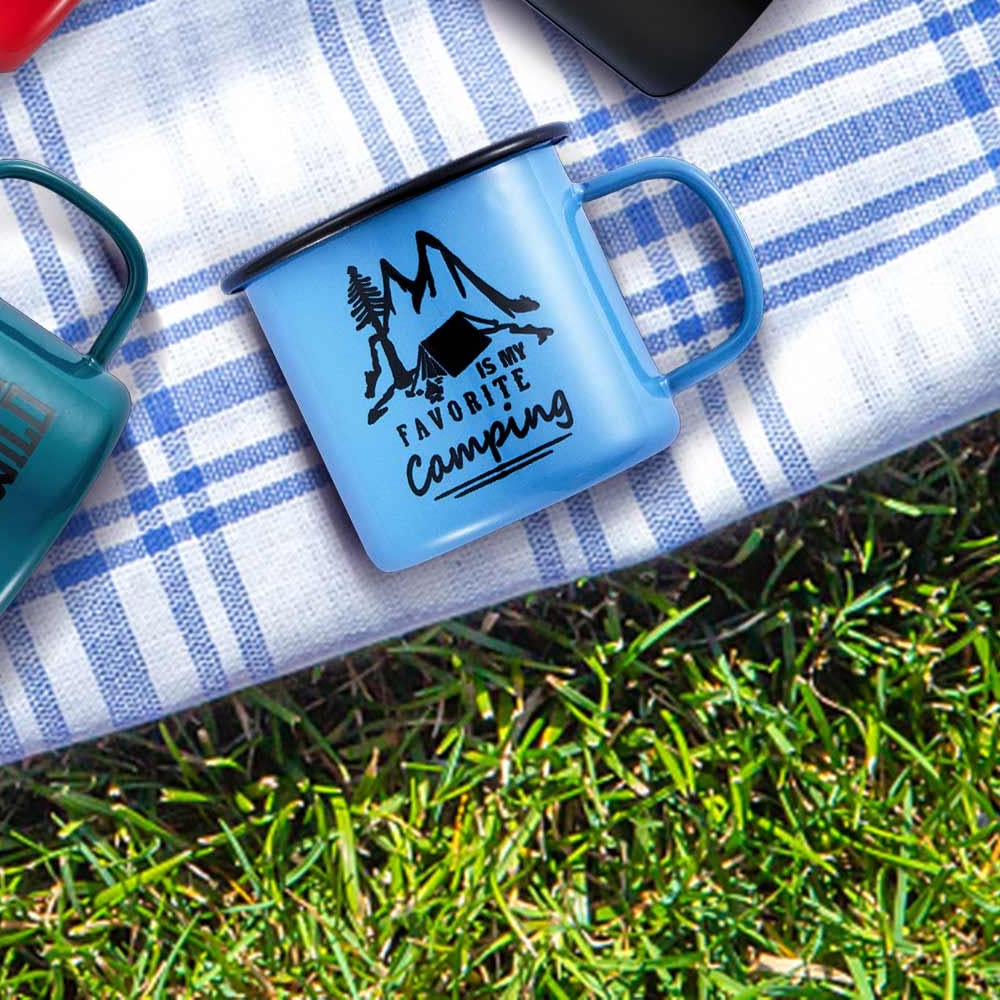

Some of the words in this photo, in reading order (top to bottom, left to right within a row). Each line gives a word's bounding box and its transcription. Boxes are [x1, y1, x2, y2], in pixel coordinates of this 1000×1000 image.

[475, 357, 497, 379] IS
[497, 341, 527, 368] MY
[396, 367, 530, 447] FAVORITE
[406, 389, 574, 497] Camping
